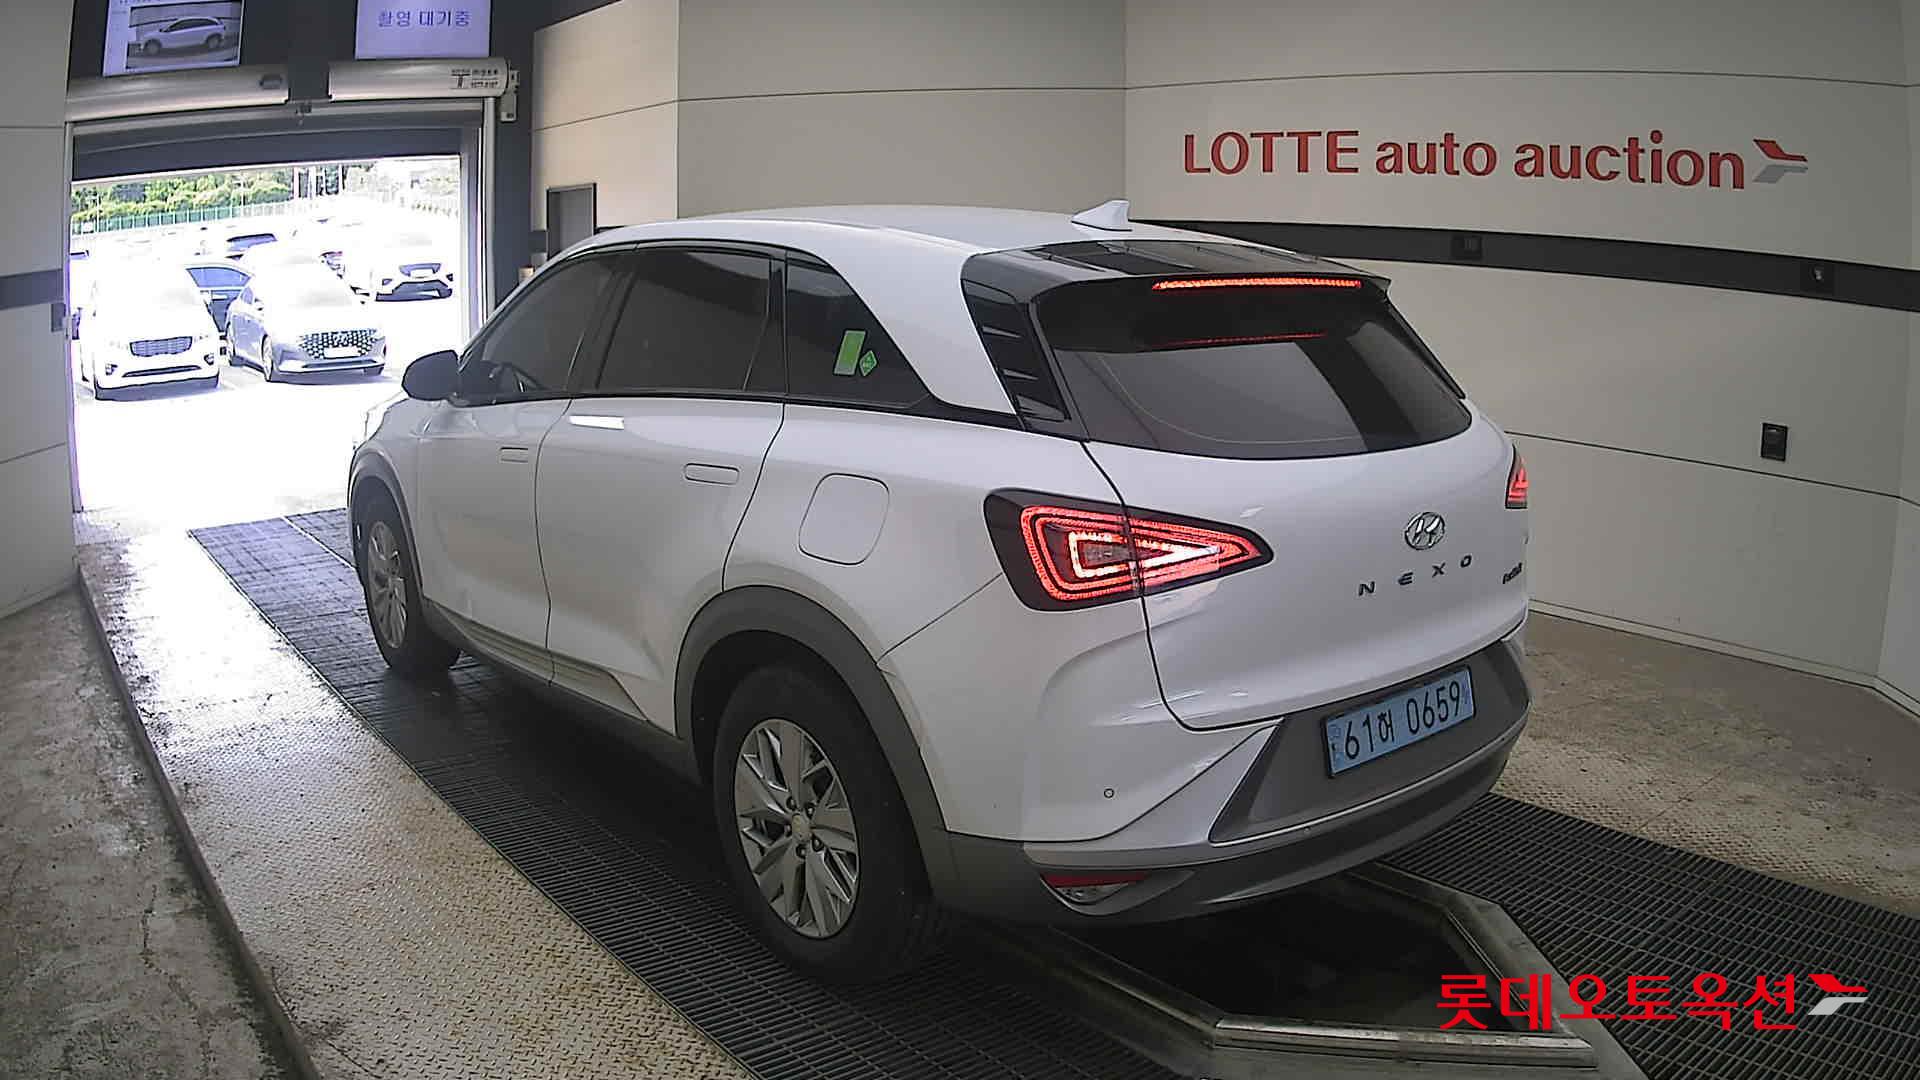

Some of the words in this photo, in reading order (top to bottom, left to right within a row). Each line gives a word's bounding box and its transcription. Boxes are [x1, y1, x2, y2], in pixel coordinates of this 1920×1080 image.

[419, 10, 470, 27] 대기중
[1184, 130, 1359, 175] LOTTE
[1375, 132, 1497, 177] auto
[1513, 130, 1745, 190] auction
[1358, 554, 1473, 597] NEXO
[1344, 708, 1396, 760] 61허
[1405, 680, 1461, 735] 0659
